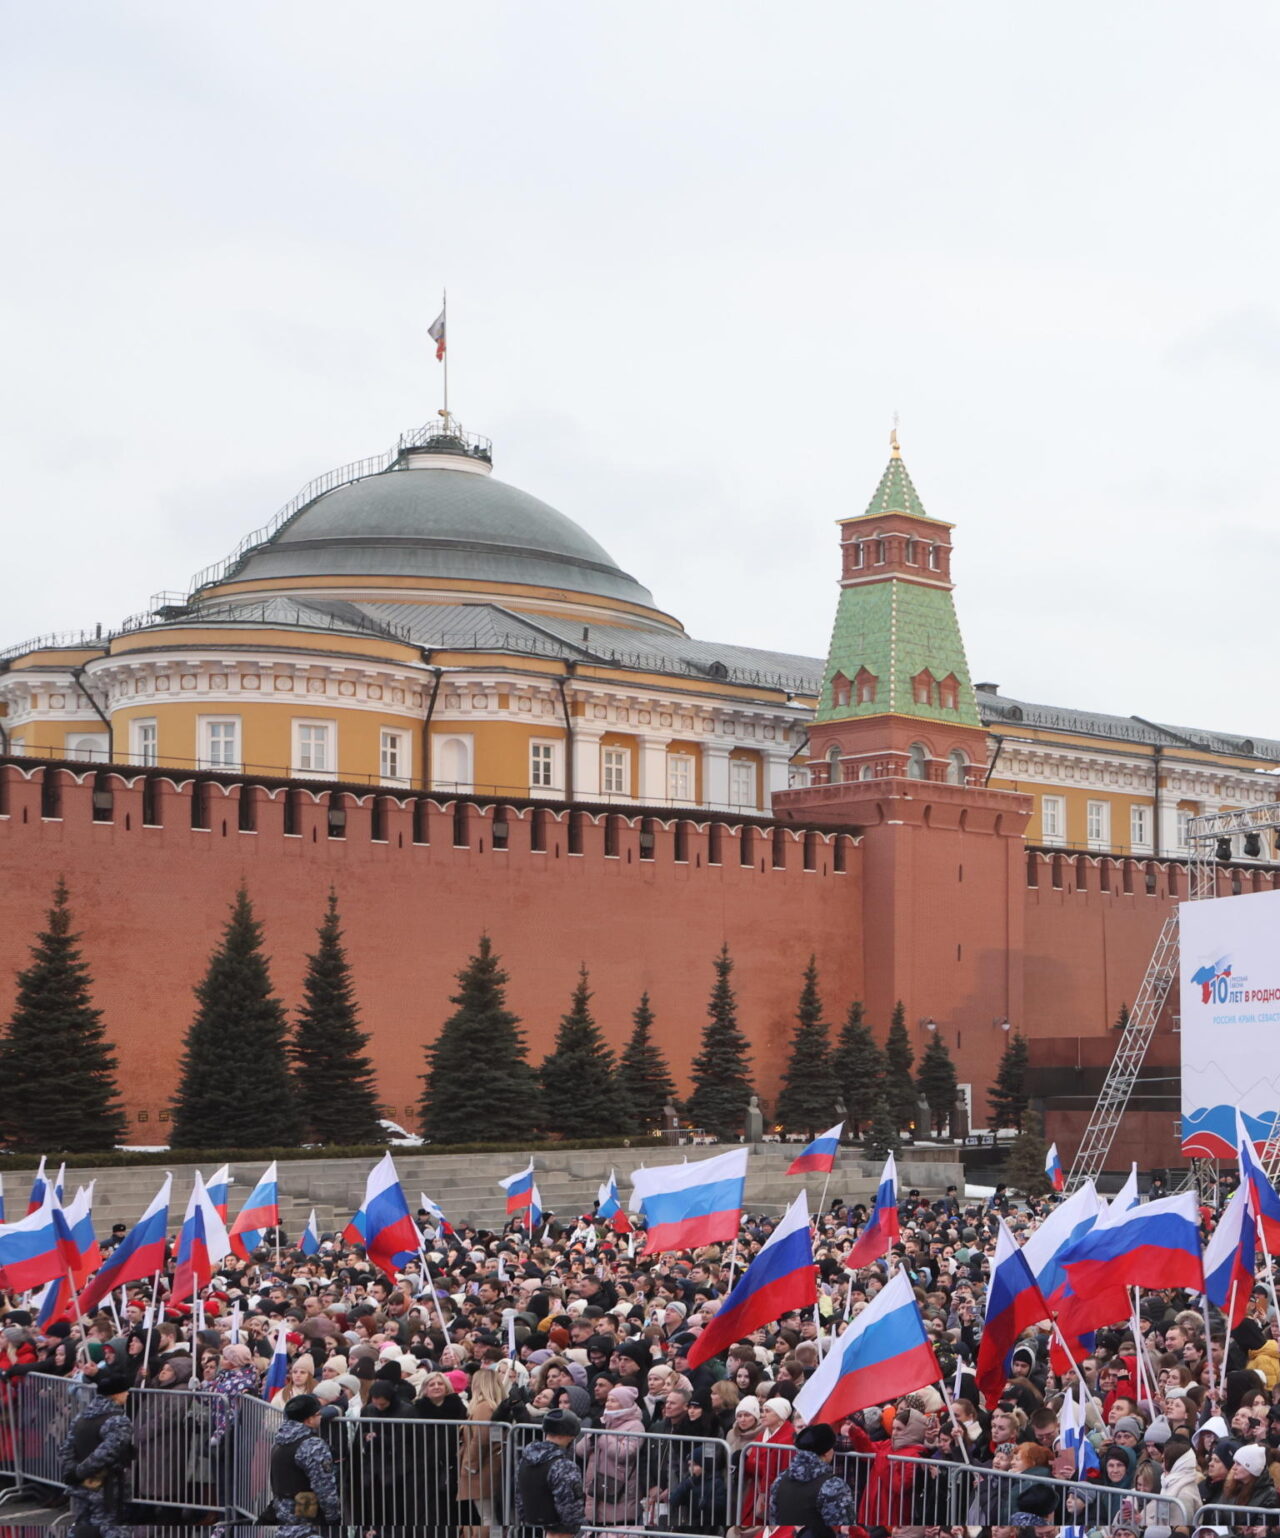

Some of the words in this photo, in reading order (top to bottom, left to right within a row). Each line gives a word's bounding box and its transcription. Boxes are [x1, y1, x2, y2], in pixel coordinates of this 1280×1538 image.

[1210, 976, 1228, 1004] 10
[1229, 990, 1244, 1003] ЛЕТ
[1244, 990, 1250, 1002] В
